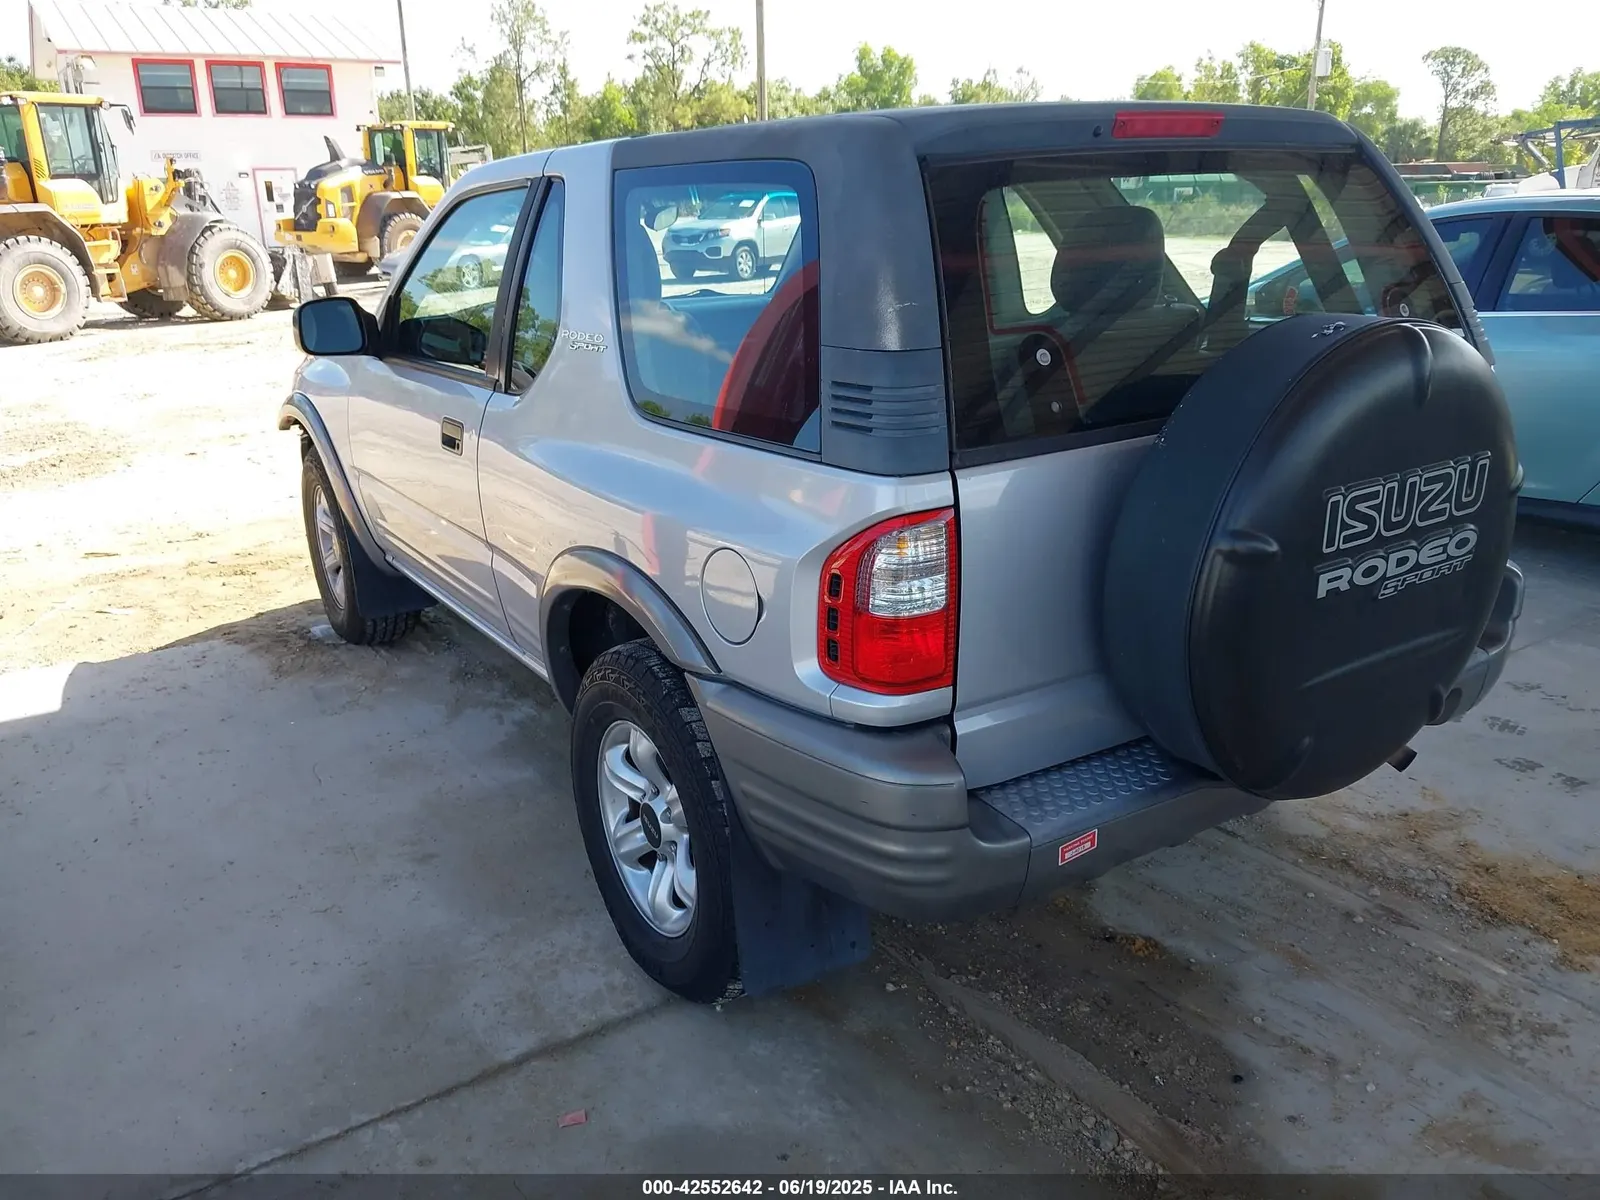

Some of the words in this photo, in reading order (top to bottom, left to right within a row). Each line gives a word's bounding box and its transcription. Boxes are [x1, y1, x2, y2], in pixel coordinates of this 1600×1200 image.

[561, 330, 604, 343] RODEO
[570, 341, 608, 353] SPORT
[1322, 455, 1491, 554] ISUZU
[1316, 526, 1479, 599] RODEO
[1378, 554, 1474, 600] SPORT
